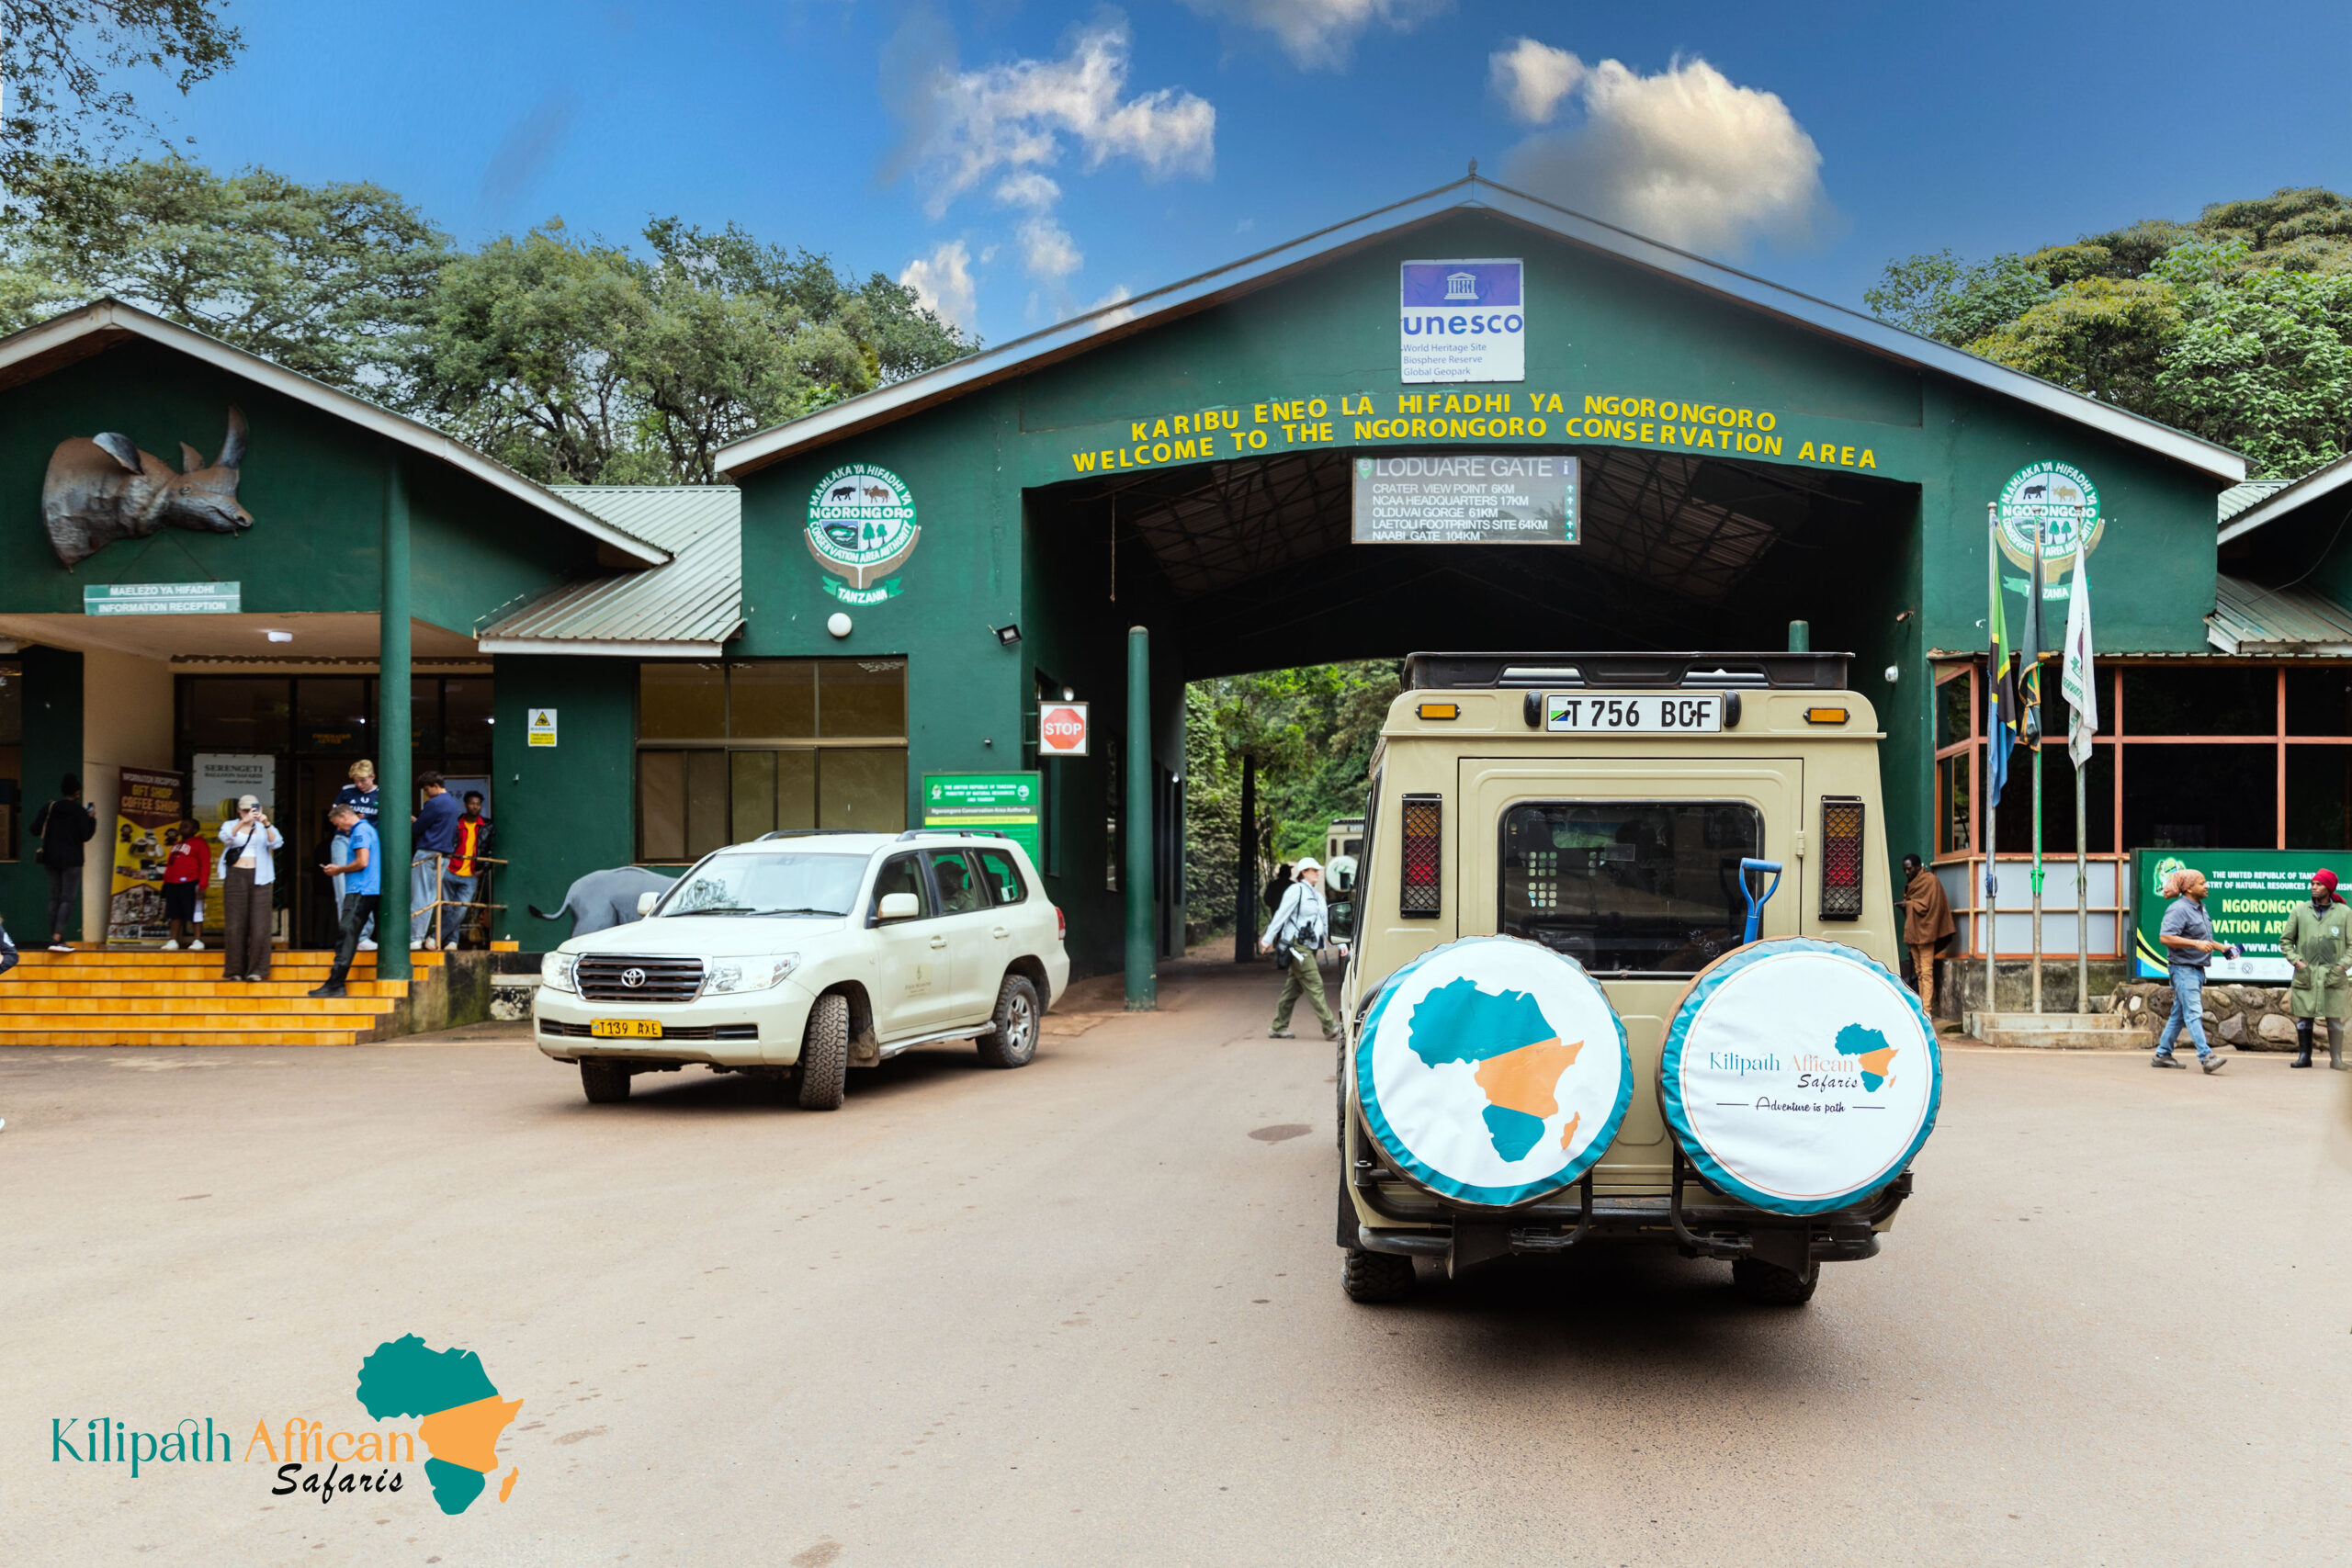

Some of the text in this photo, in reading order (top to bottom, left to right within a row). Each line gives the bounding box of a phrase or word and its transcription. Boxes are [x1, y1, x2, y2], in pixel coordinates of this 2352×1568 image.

[1404, 314, 1522, 334] unesco
[1431, 344, 1468, 353] Heritage
[1404, 355, 1446, 365] Biosphere
[1404, 367, 1470, 378] Global Geopark
[1132, 393, 1776, 442] KARIBU ENEO LA HIFADHI YA NGORONGORO
[1072, 416, 1876, 473] WELCOME TO THE NGORONGORO CONSERVATION AREA
[1376, 457, 1553, 478] LODUARE GATE
[809, 465, 912, 506] MAMLAKA YA HIFADHI YA
[1373, 483, 1514, 494] CRATER VIEW POINT 6KM
[2001, 462, 2098, 505] MAMLAKA YA HIFADHI YA
[1373, 496, 1529, 505] NCAA HEADQUARTERS 17KM
[810, 507, 914, 518] NGORONGORO
[1373, 508, 1498, 518] OLDUVAI GORGE 61KM
[1373, 520, 1547, 529] LAETOLI FOOTPRINTS SITE 64KM
[809, 520, 912, 562] CONSERVATION AREA AUTHORITY
[1373, 532, 1480, 541] NAABI GATE 104KM
[2045, 546, 2065, 557] AREA
[110, 585, 215, 595] MAELEZO YA HIFADHI
[838, 588, 888, 604] TANZANIA
[98, 602, 226, 613] INFORMATION RECEPTION
[1567, 701, 1712, 727] T 756 BCF
[1046, 723, 1082, 735] STOP
[132, 784, 173, 798] GIFT SHOP
[121, 795, 180, 812] COFFEE SHOP
[638, 1022, 658, 1034] AXE
[1710, 1052, 1780, 1076] Kilipath
[1797, 1074, 1858, 1092] Safaris
[1755, 1097, 1845, 1113] Adventure is path
